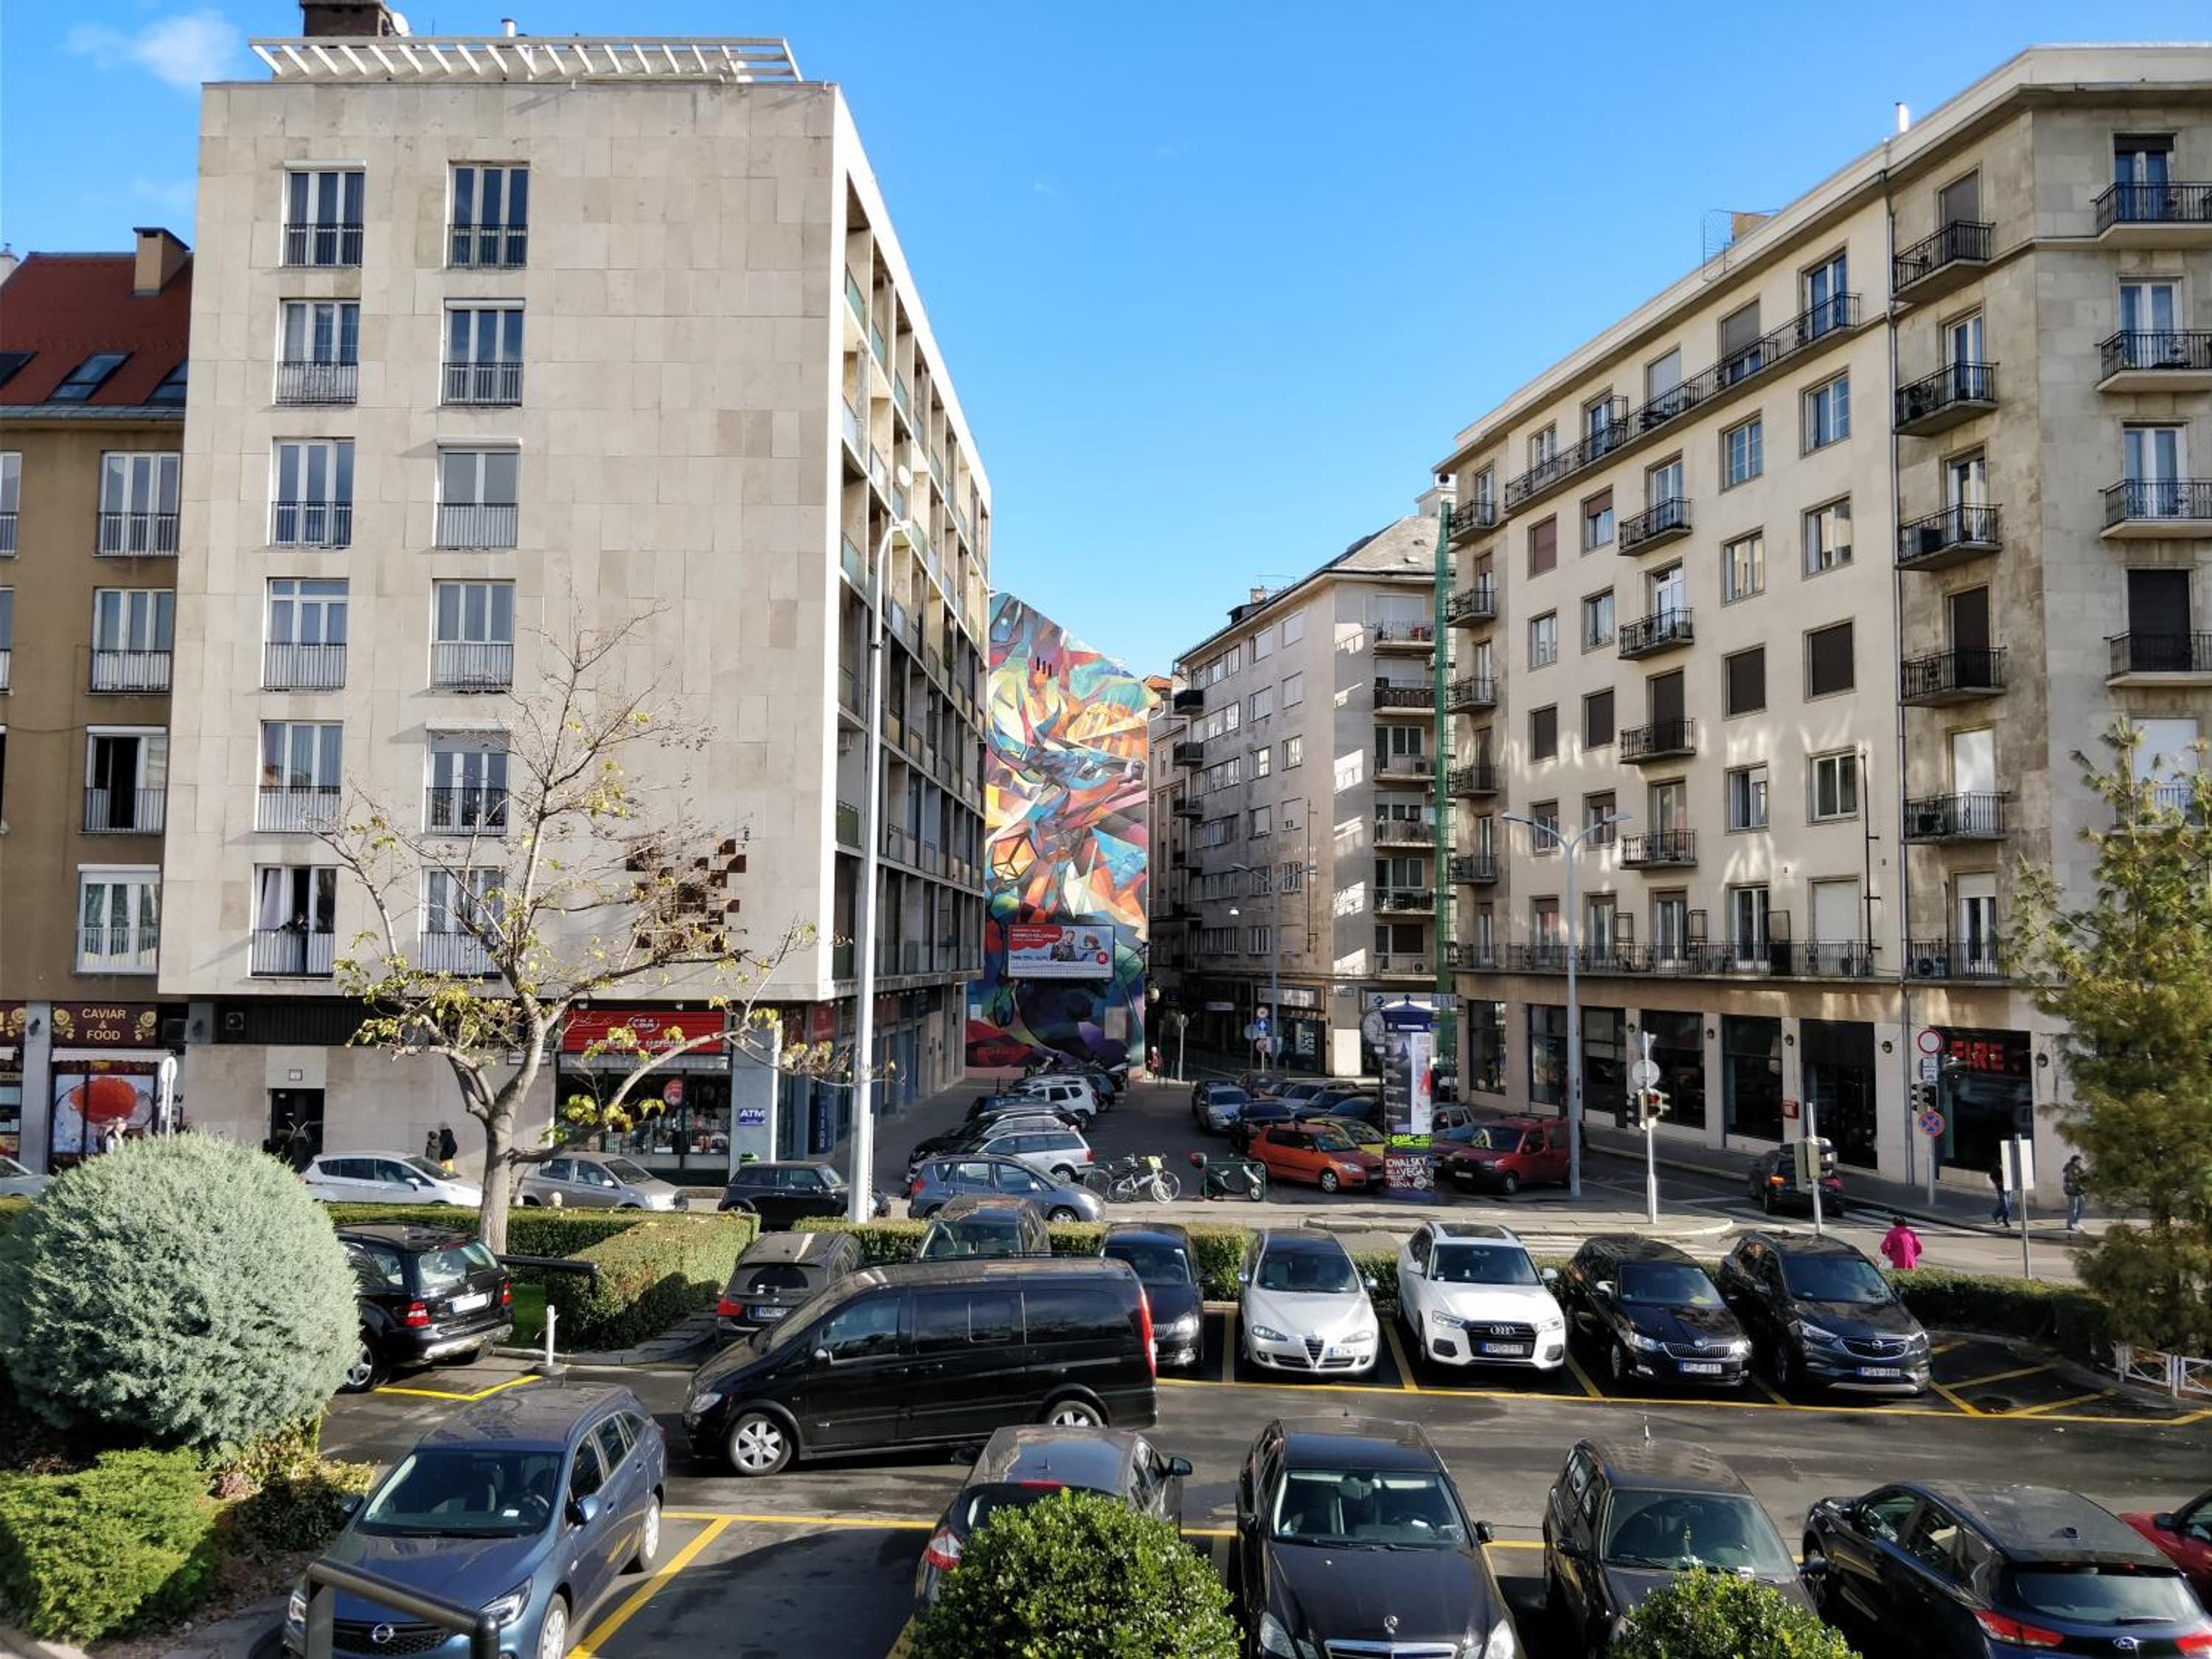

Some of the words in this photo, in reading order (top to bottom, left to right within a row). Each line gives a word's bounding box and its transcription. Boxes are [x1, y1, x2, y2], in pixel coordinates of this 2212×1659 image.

[82, 1008, 126, 1019] CAVIAR
[99, 1020, 107, 1029] &
[86, 1030, 120, 1041] FOOD
[1950, 1040, 2004, 1071] FIRE
[740, 1109, 765, 1118] ATM
